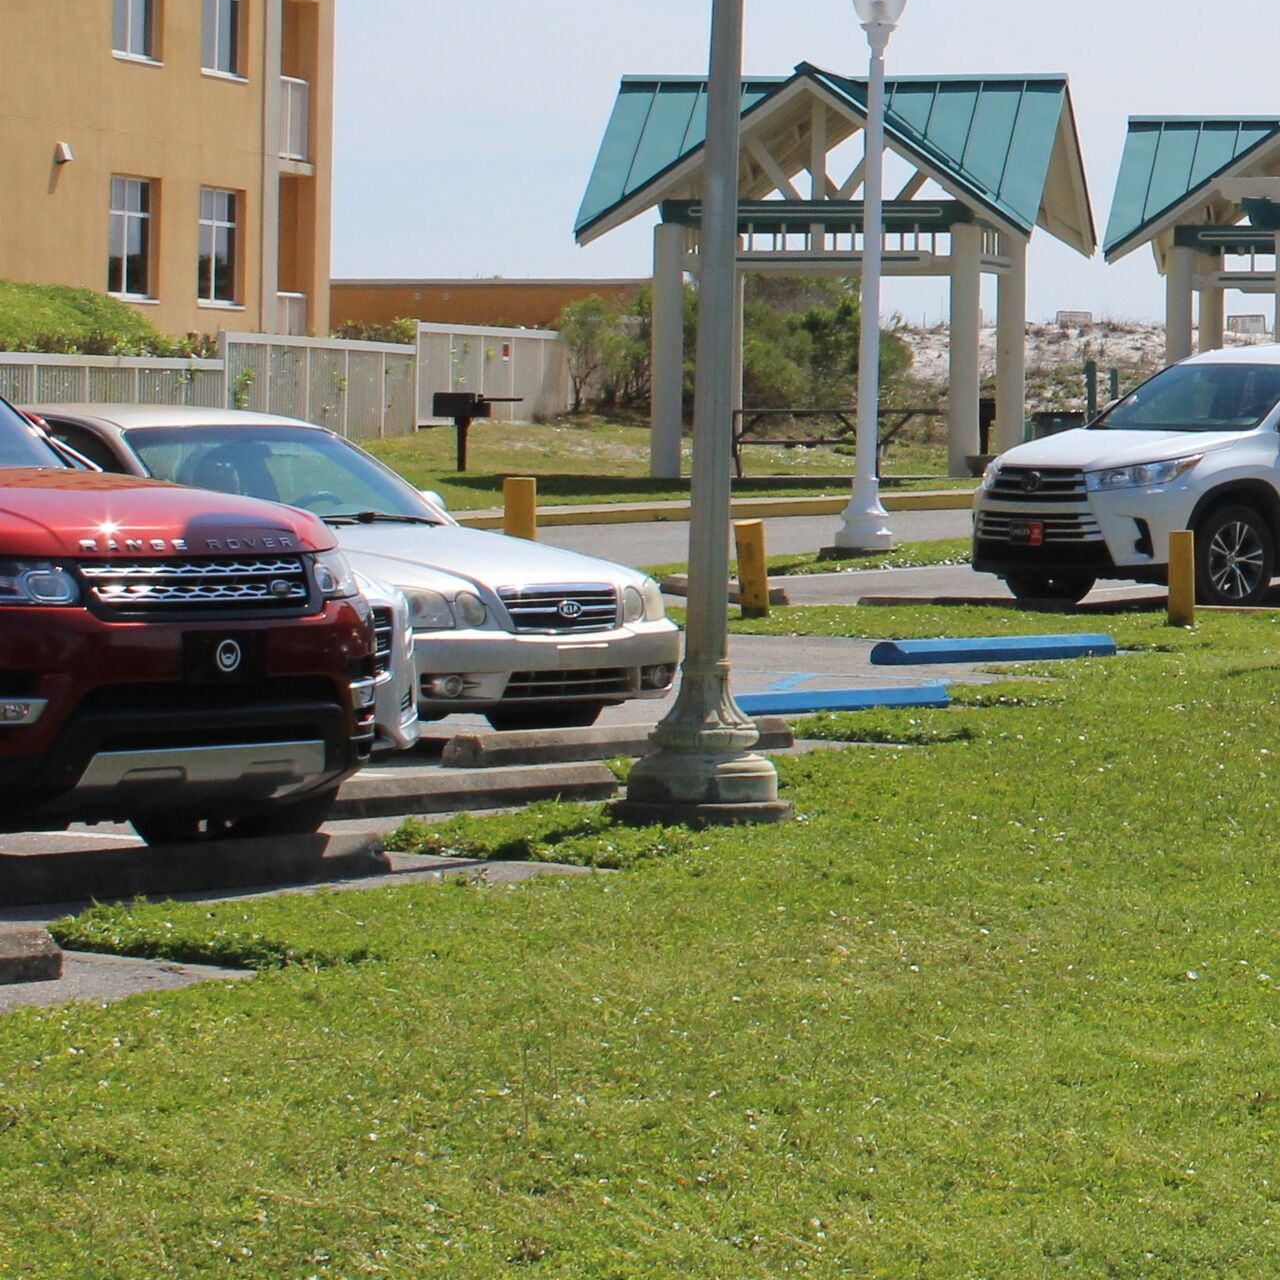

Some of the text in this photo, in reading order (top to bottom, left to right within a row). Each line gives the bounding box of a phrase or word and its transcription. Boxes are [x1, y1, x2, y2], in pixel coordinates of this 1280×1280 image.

[78, 537, 293, 552] RANGE ROVER
[562, 604, 580, 614] KIA
